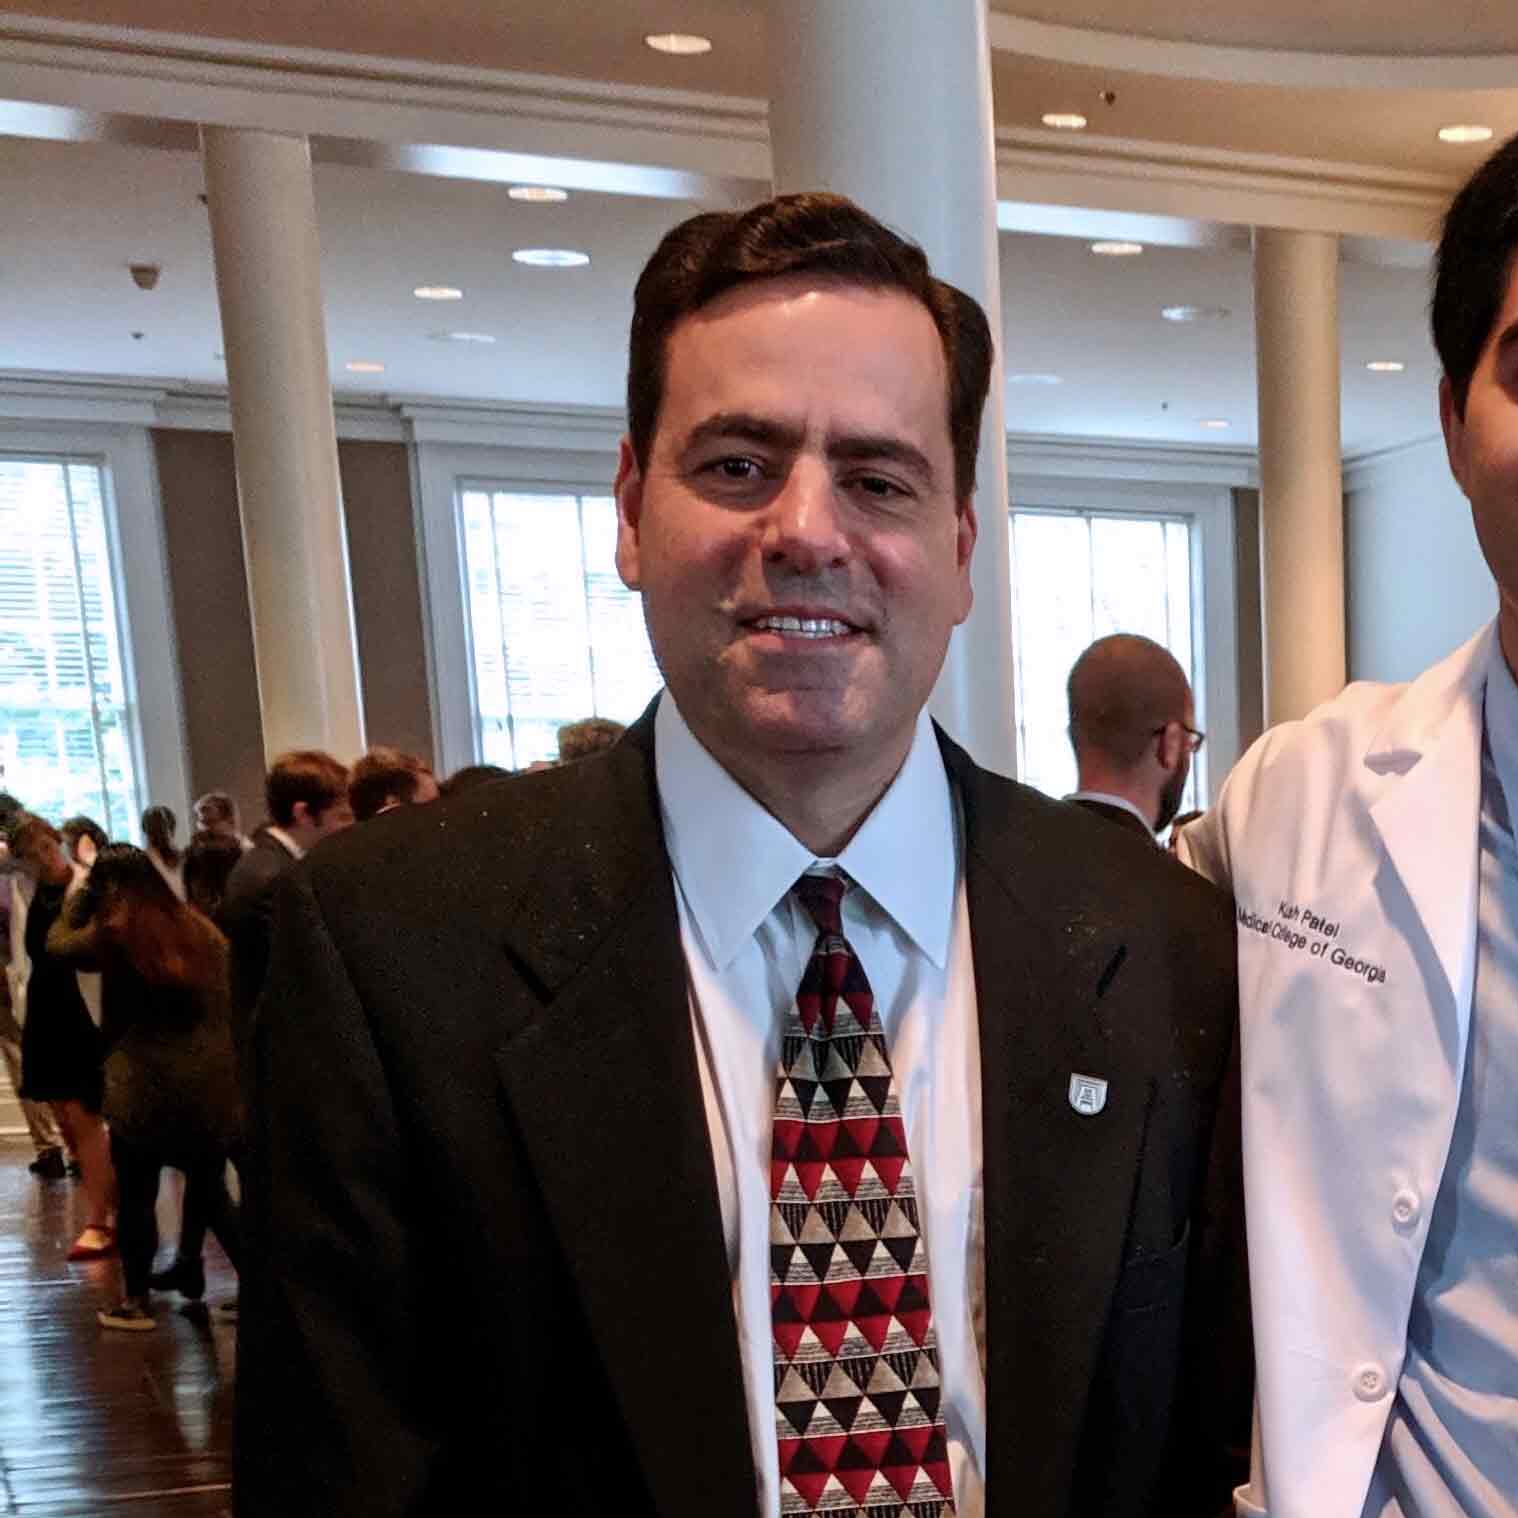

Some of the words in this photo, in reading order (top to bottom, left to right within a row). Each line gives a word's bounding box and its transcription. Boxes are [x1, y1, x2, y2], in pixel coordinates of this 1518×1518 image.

[1301, 910, 1341, 938] Patel
[1271, 922, 1307, 949] College
[1310, 941, 1328, 958] of
[1330, 948, 1387, 983] Georgia
